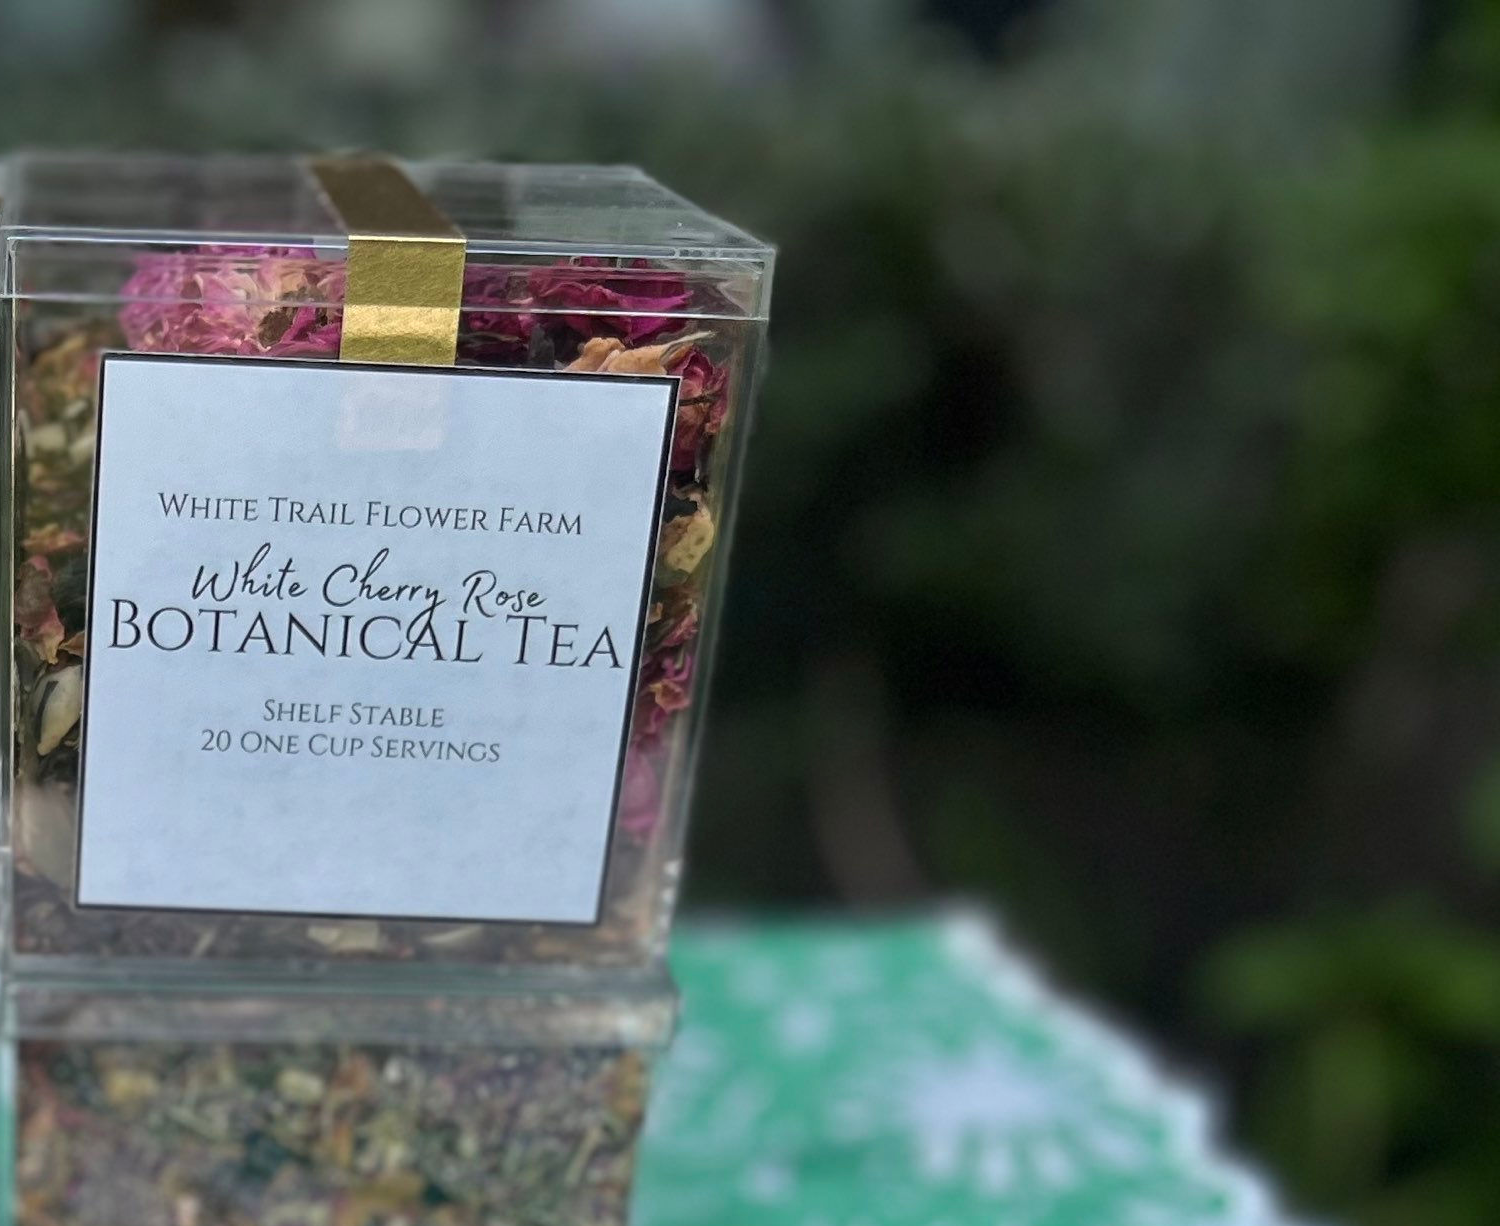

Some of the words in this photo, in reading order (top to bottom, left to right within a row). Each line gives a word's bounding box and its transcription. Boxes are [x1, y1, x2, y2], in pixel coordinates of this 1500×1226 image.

[158, 492, 259, 522] WHITE
[268, 496, 354, 526] TRAIL
[366, 501, 488, 532] FLOWER
[498, 506, 582, 536] FARM
[192, 542, 308, 602] White
[322, 546, 448, 645] Cherry
[463, 570, 547, 618] Rose
[108, 598, 483, 663] BOTANICAL
[506, 614, 624, 669] TEA
[263, 698, 342, 725] SHELF
[350, 702, 445, 728] STABLE
[200, 730, 232, 752] 20
[240, 732, 299, 756] ONE
[308, 733, 364, 757] CUP
[370, 736, 500, 762] SERVINGS
